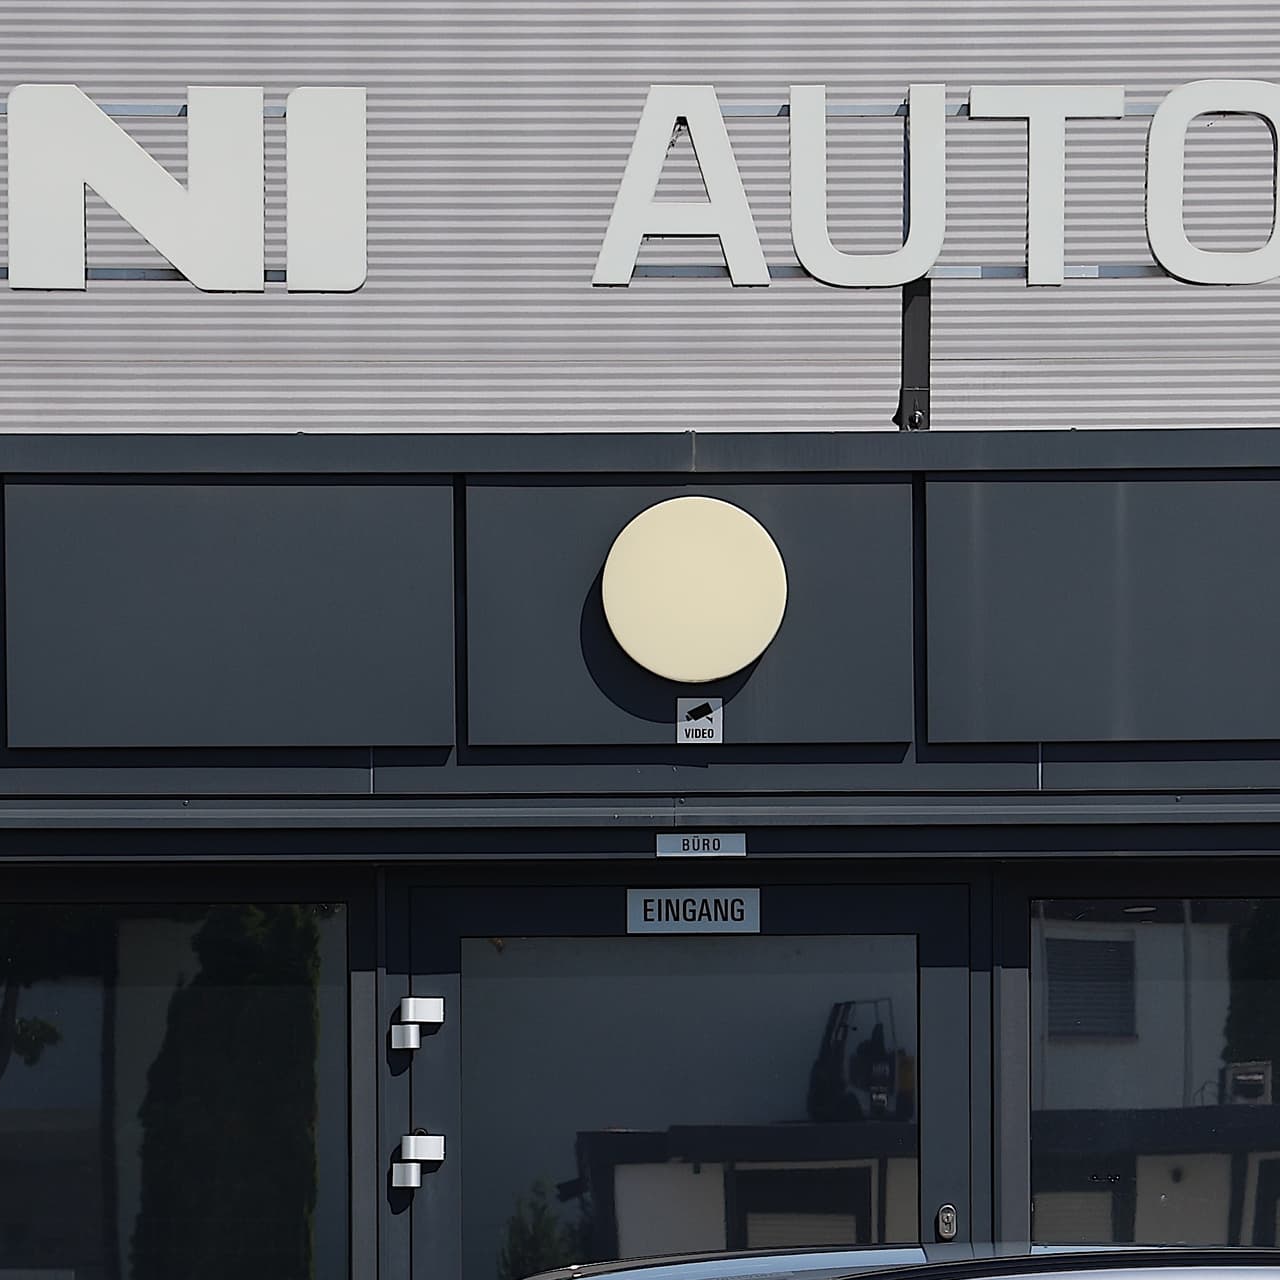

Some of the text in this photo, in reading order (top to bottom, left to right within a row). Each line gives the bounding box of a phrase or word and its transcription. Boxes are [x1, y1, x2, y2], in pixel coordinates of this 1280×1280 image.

[684, 728, 715, 739] VIDEO
[682, 835, 721, 852] BÜRO
[643, 898, 746, 922] EINGANG
